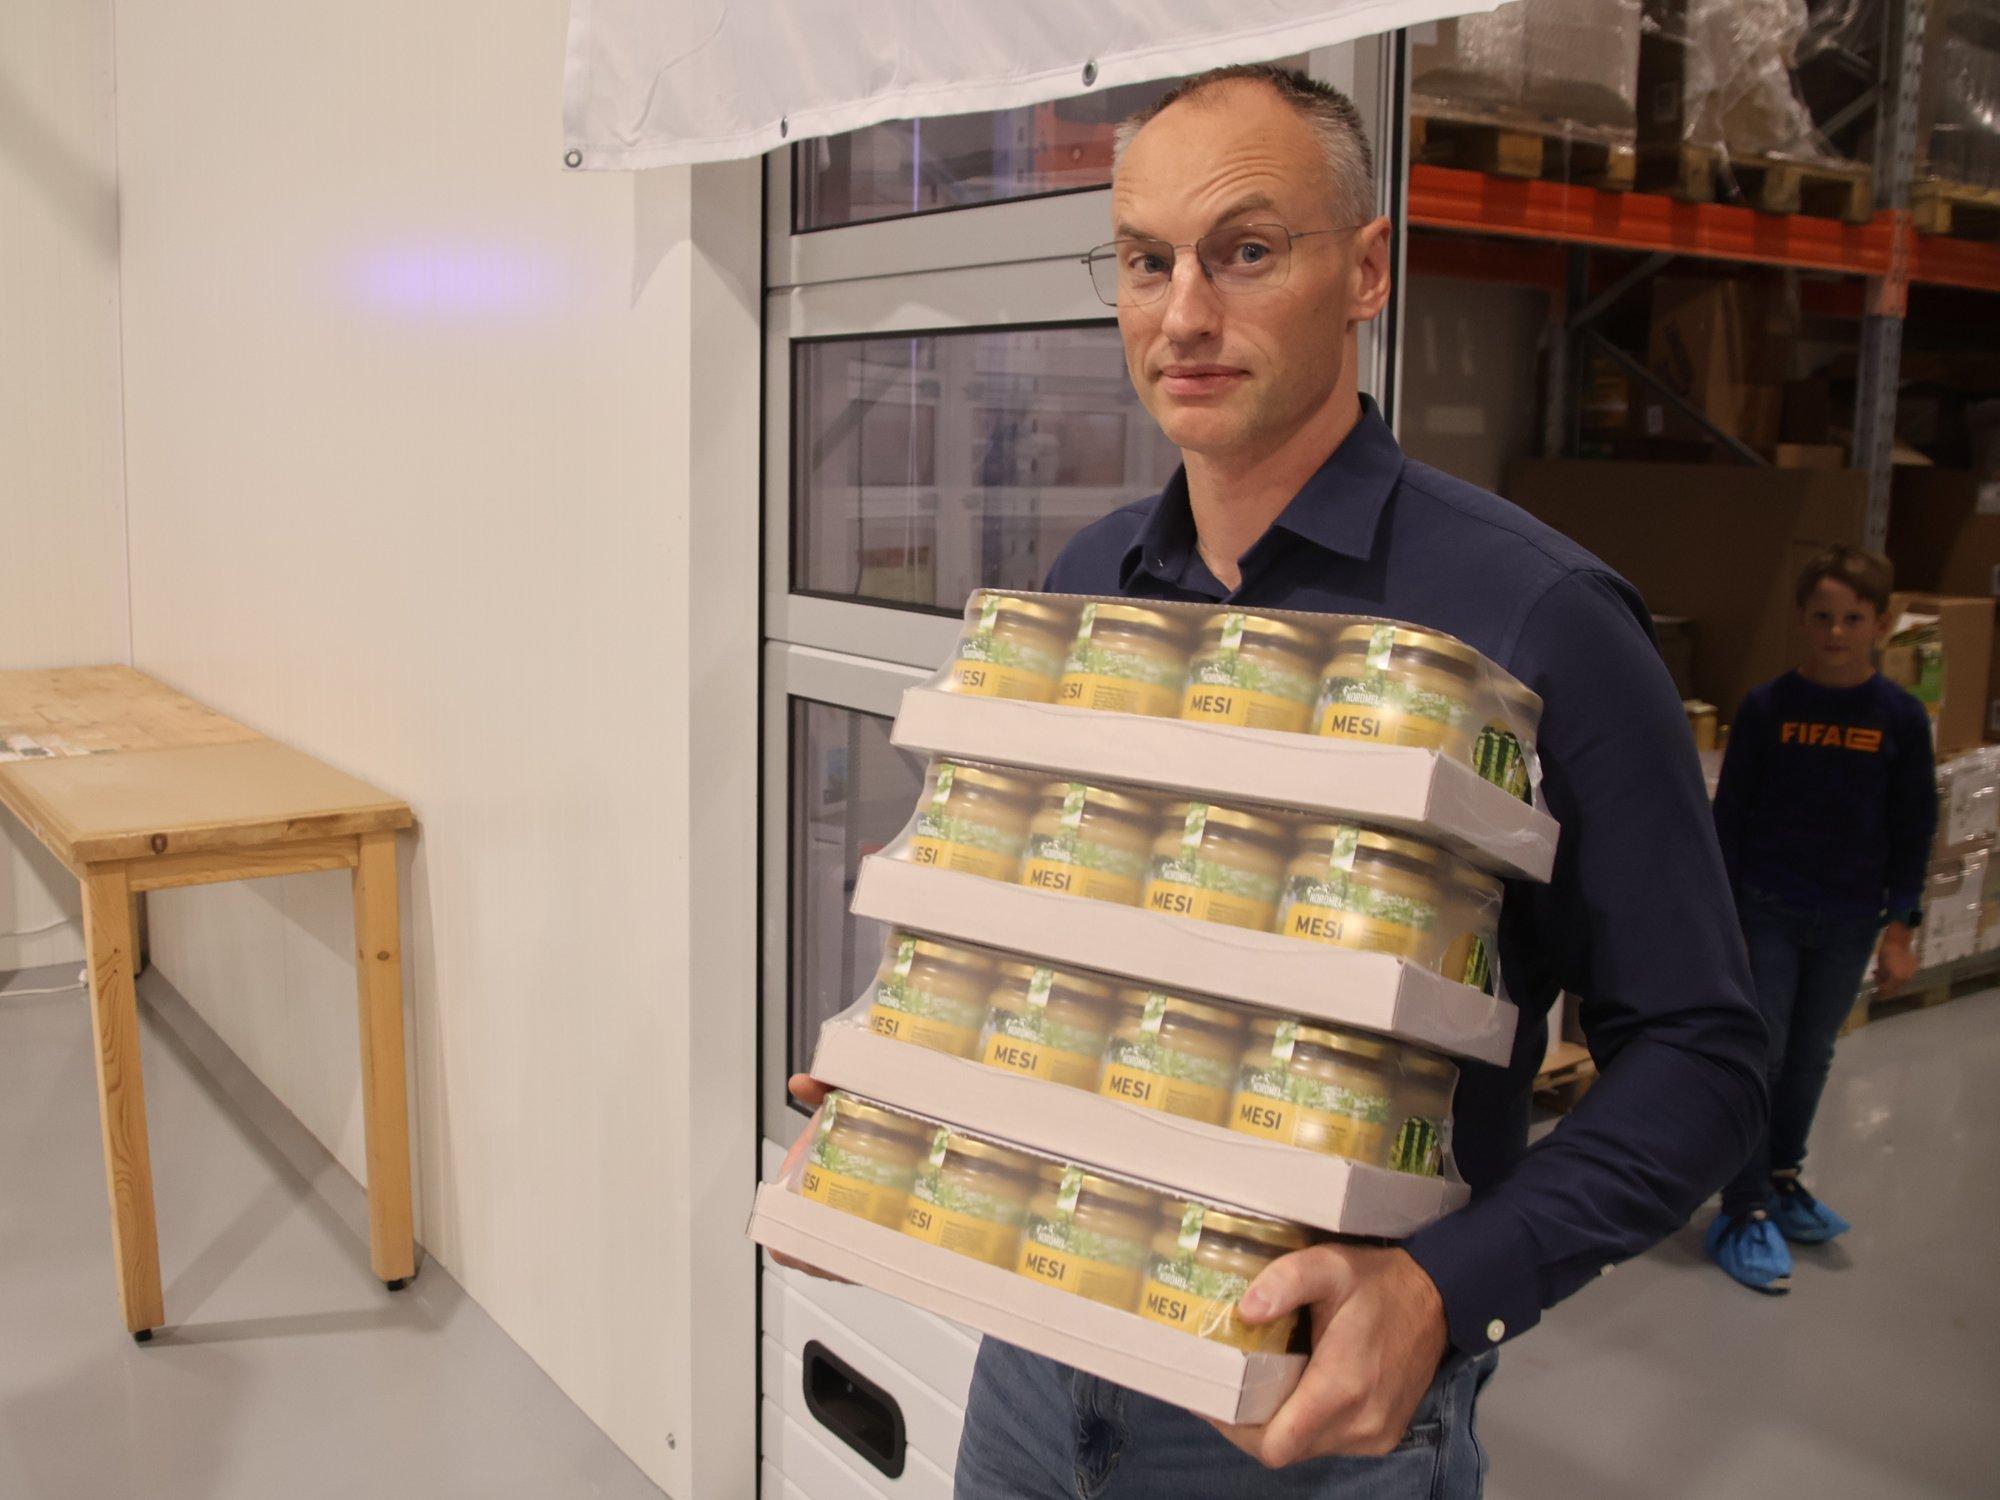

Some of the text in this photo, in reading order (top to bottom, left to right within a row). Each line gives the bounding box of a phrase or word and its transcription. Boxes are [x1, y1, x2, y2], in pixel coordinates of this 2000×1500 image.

[1062, 682, 1083, 700] ESI
[1190, 694, 1232, 714] MESI
[1331, 714, 1380, 737] MESI
[915, 846, 938, 865] ESI
[1031, 868, 1071, 891] MESI
[1152, 890, 1193, 914] MESI
[1295, 914, 1343, 940] MESI
[994, 1045, 1038, 1071] MESI
[1109, 1074, 1151, 1101] MESI
[1240, 1103, 1282, 1131] MESI
[910, 1207, 933, 1231] ESI
[1025, 1252, 1066, 1281] MESI
[1147, 1293, 1187, 1322] MESI
